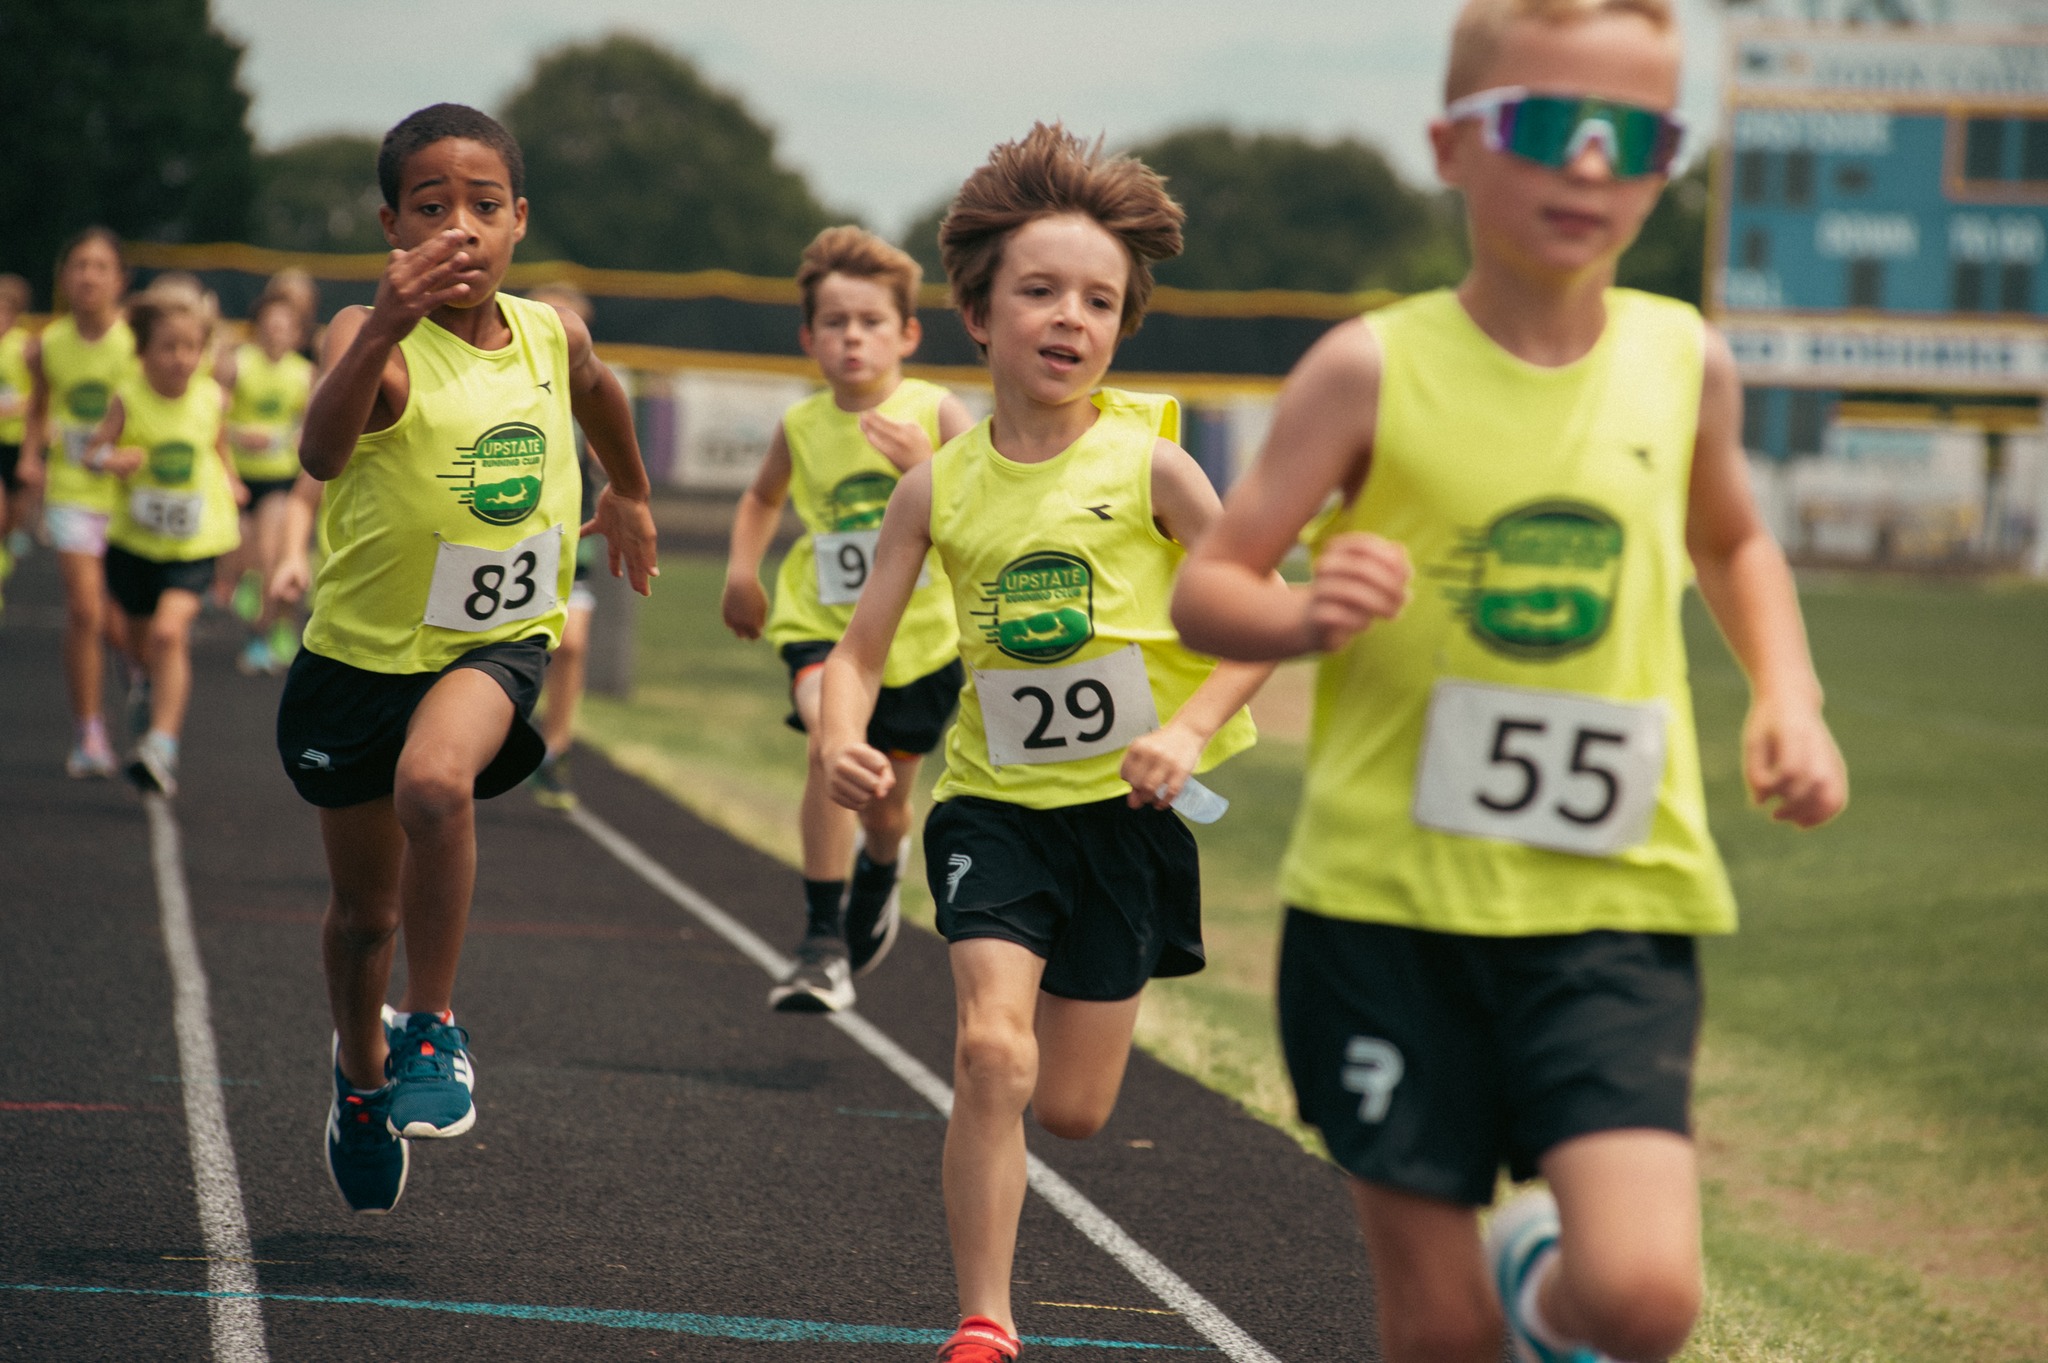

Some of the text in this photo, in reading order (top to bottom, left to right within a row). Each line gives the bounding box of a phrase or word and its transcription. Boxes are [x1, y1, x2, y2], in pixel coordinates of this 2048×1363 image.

[482, 438, 541, 456] UPSTATE
[482, 458, 520, 468] RUNNING
[464, 550, 537, 621] 83
[839, 544, 877, 589] 9
[1005, 568, 1081, 590] UPSTATE
[1011, 678, 1115, 750] 29
[1474, 715, 1628, 827] 55
